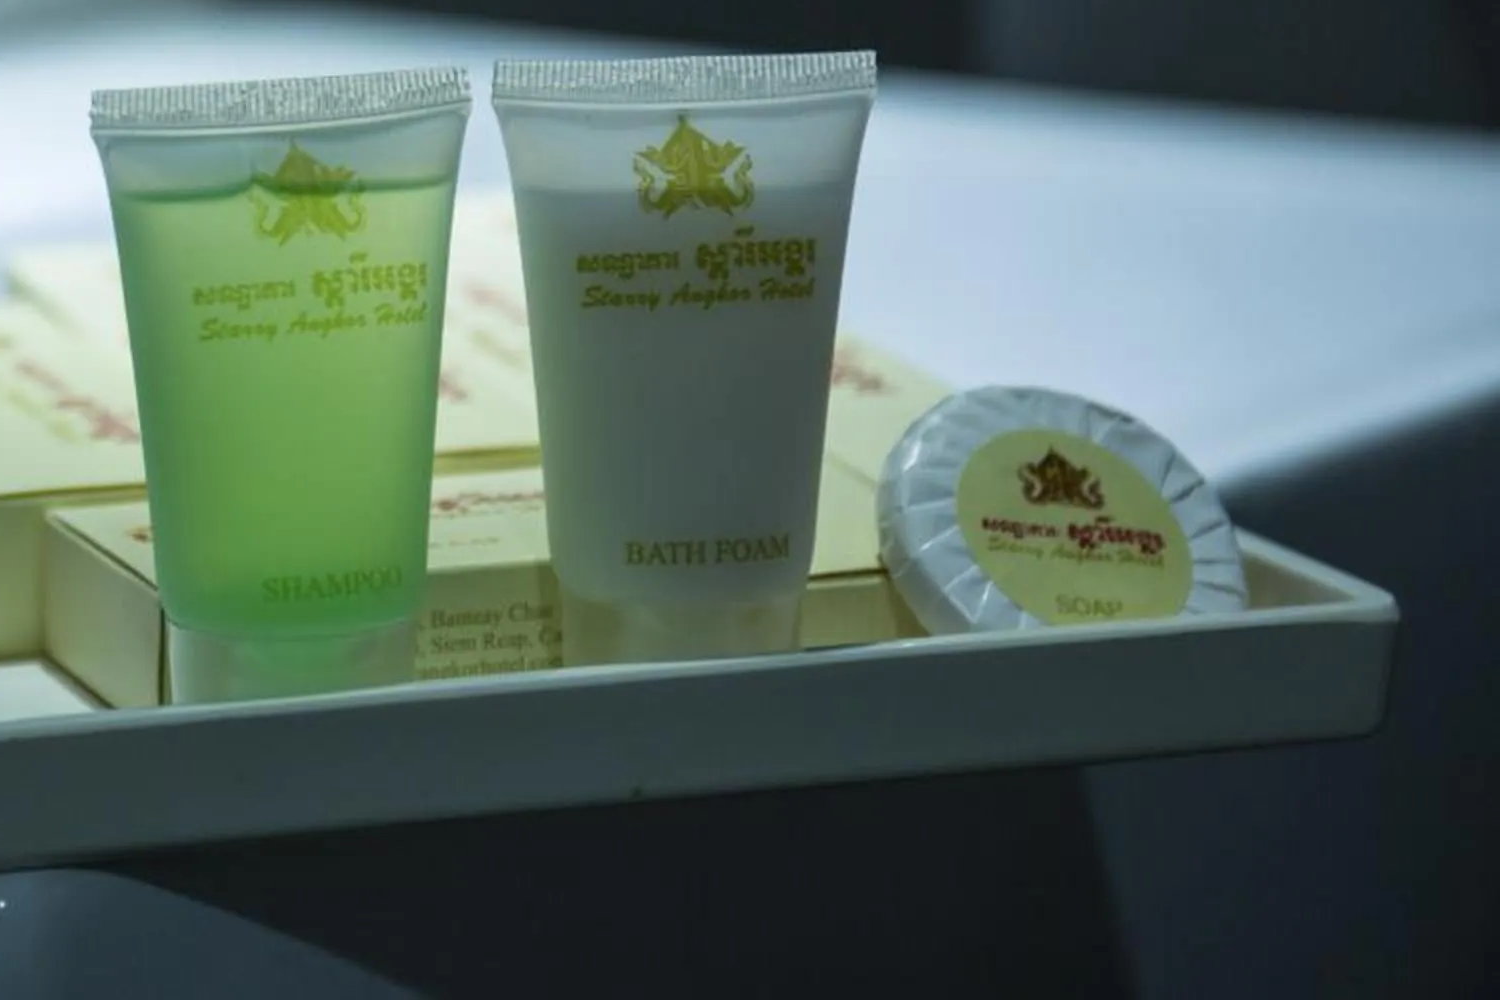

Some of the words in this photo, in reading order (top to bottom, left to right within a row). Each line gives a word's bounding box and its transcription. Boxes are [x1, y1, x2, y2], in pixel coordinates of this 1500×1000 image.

[668, 281, 752, 310] Angkor
[758, 276, 816, 301] Hotel
[286, 308, 367, 339] Angkor
[374, 301, 428, 326] Hotel
[624, 541, 706, 566] BATH
[714, 533, 789, 564] FOAM
[261, 566, 402, 602] SHAMPOO
[1055, 593, 1124, 617] SOAP
[431, 635, 477, 654] Siem
